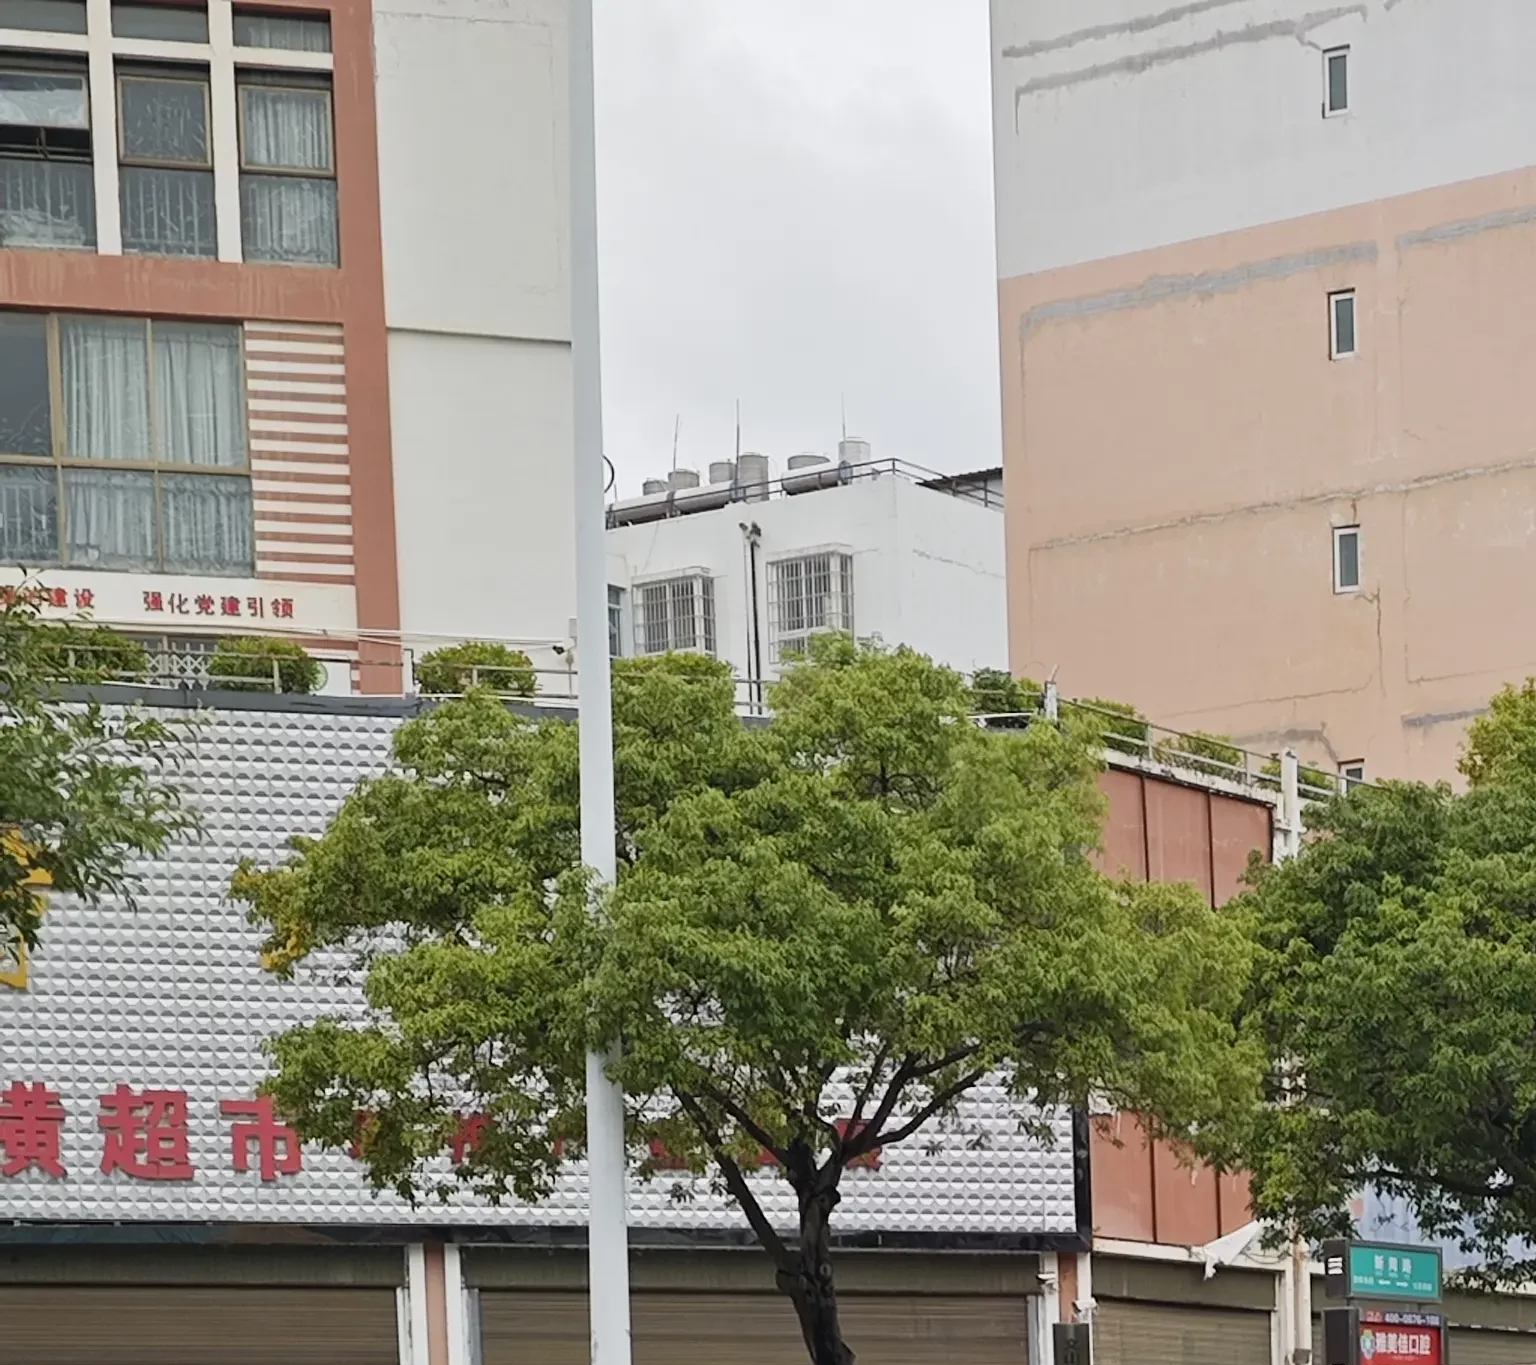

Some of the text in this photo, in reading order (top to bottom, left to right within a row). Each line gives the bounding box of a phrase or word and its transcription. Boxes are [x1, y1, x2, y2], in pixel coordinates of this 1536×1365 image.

[142, 590, 295, 619] 强化党建引领
